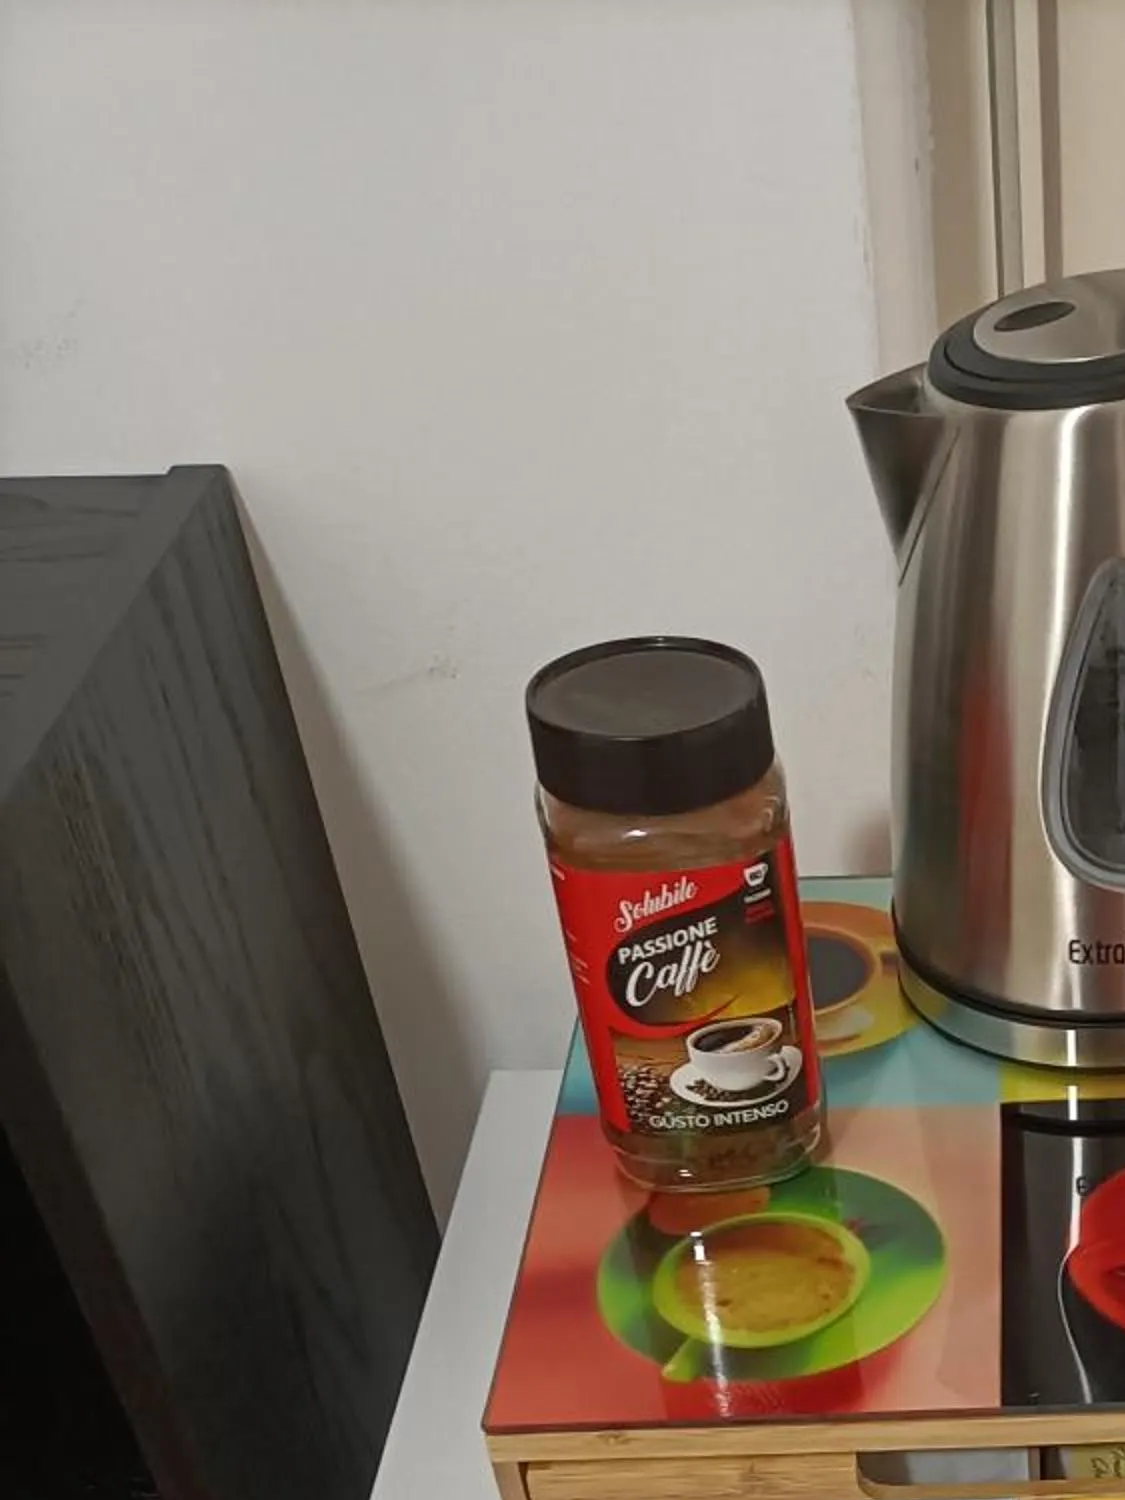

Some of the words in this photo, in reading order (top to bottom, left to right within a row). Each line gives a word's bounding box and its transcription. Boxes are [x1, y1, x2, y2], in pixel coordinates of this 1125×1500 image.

[613, 875, 698, 933] Solubile
[618, 916, 718, 965] PASSIONE
[625, 940, 721, 1007] Caffè
[650, 1110, 711, 1129] GUSTO
[713, 1100, 790, 1127] INTENSO
